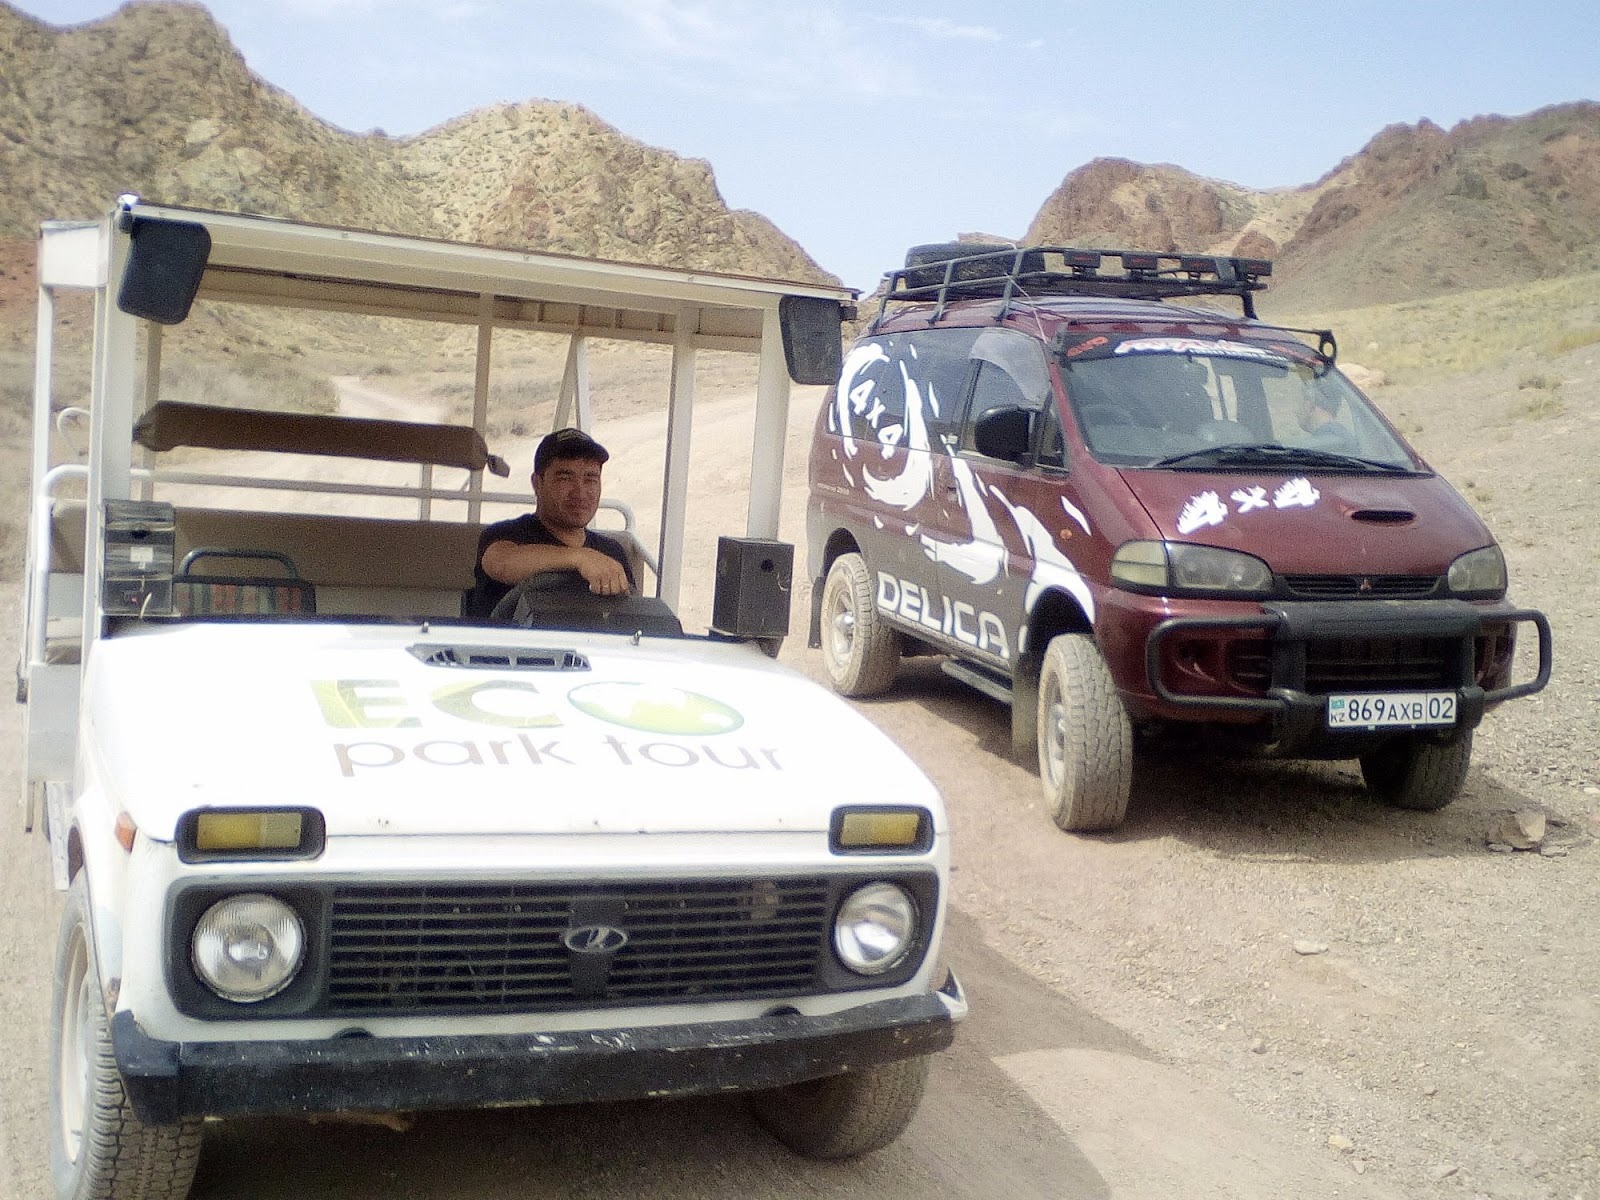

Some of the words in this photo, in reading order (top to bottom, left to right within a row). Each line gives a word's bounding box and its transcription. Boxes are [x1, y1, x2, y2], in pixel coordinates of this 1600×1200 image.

[876, 571, 1010, 659] DELICA
[310, 679, 745, 736] ECO
[333, 733, 576, 777] park
[602, 734, 784, 772] tour
